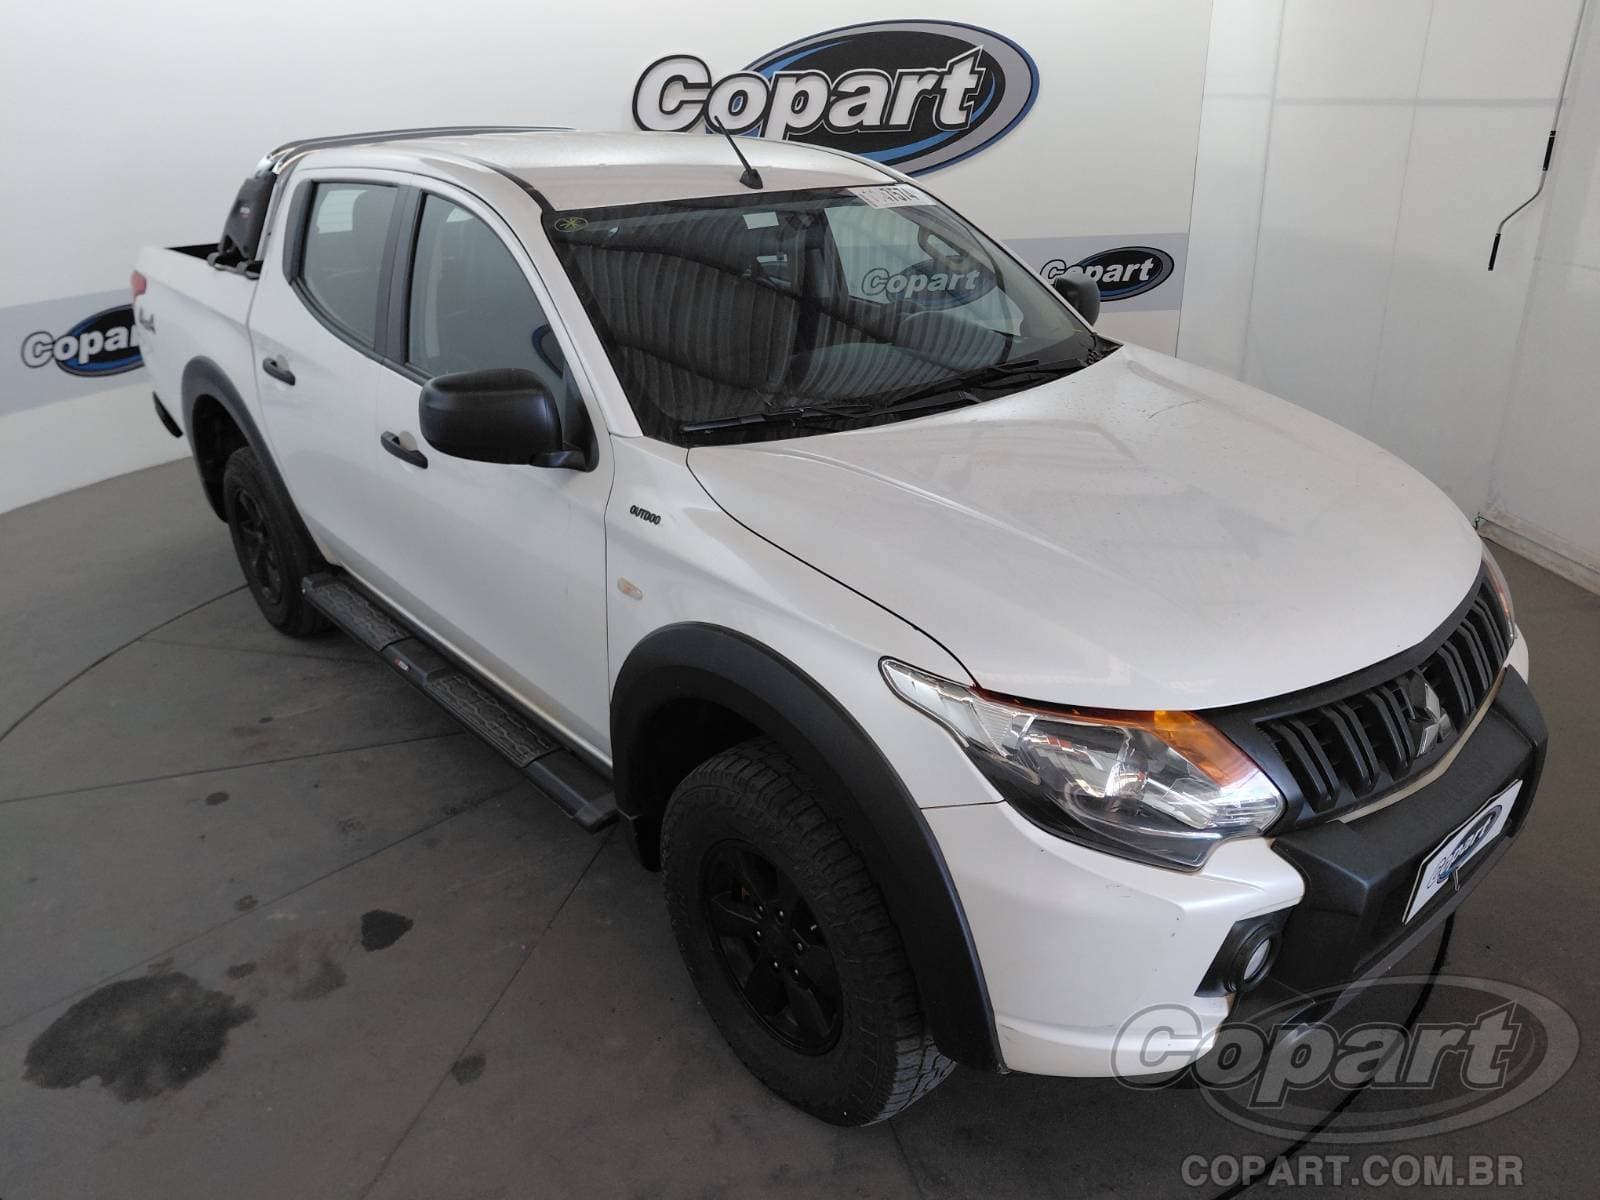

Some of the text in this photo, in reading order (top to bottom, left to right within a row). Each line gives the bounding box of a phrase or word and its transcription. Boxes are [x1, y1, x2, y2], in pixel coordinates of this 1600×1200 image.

[632, 45, 986, 139] Copart
[861, 268, 981, 299] Copart
[21, 325, 140, 369] Copa
[629, 504, 662, 526] OUTDOO
